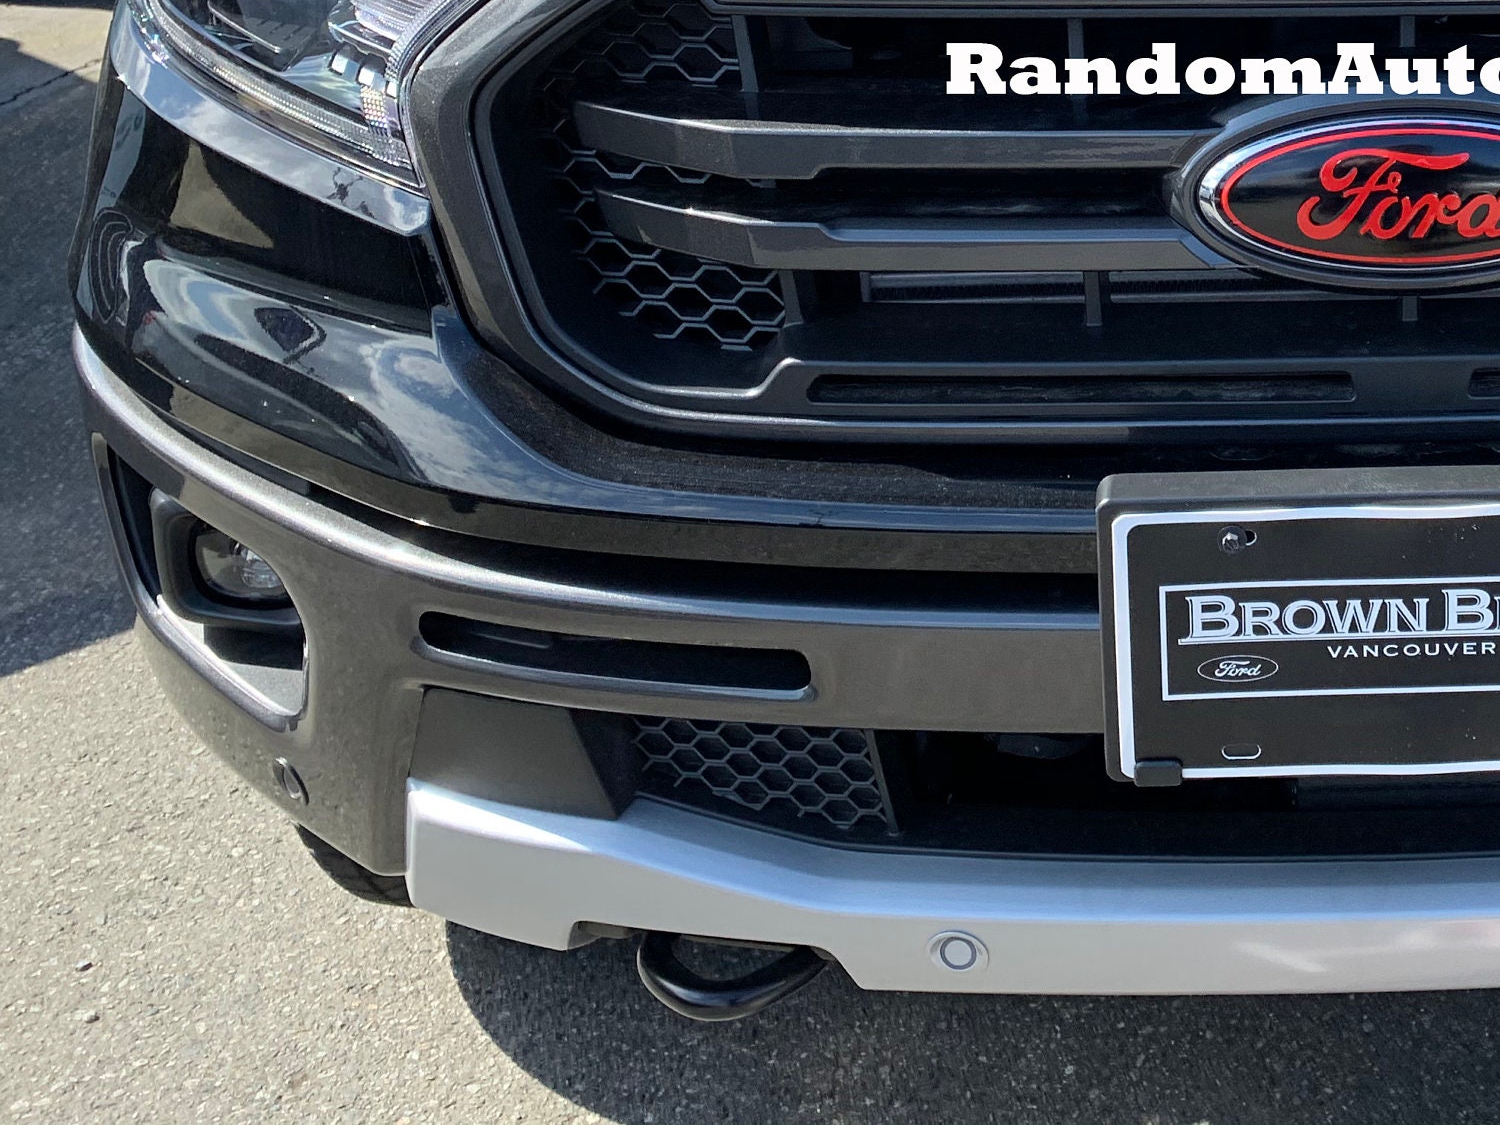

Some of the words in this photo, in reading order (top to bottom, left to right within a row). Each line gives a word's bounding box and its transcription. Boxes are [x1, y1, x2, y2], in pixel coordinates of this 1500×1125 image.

[1183, 594, 1430, 639] BROWN
[1326, 640, 1497, 660] VANCOUVER
[1213, 659, 1262, 678] Ford
